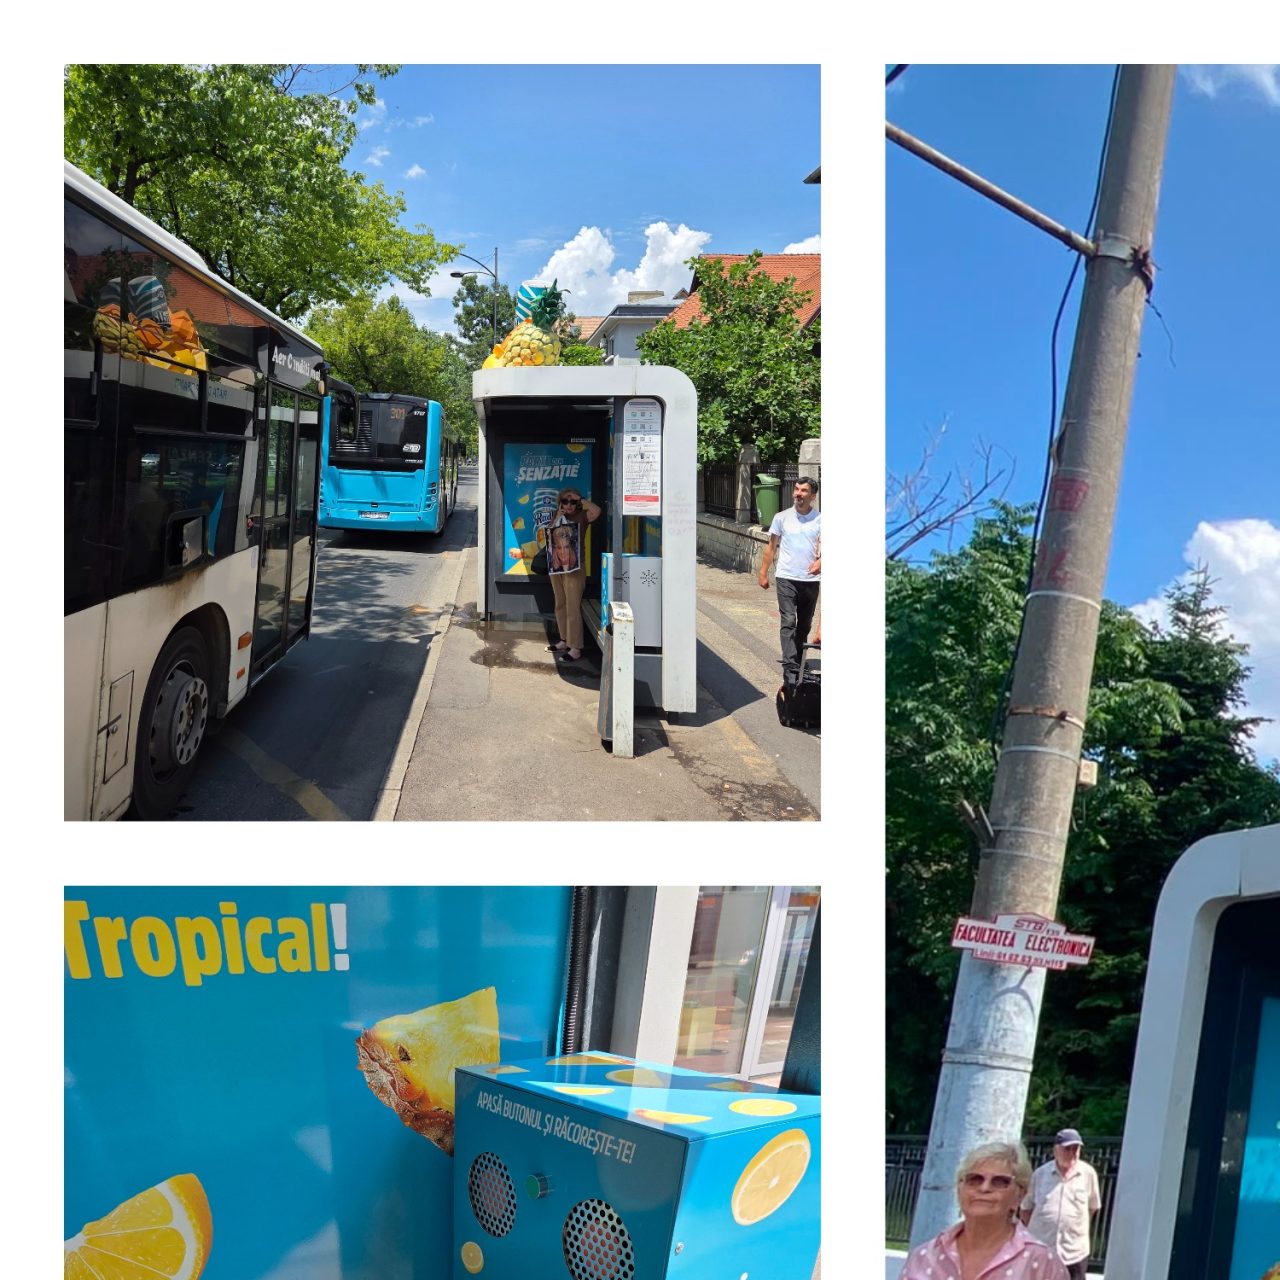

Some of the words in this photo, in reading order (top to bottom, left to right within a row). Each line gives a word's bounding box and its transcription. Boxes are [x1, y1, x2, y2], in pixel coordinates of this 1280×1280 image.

[64, 900, 350, 986] Tropical!
[955, 924, 1016, 948] FACULTATEA
[1025, 934, 1092, 958] ELECTRONICA
[477, 1091, 503, 1114] APASĂ
[503, 1100, 542, 1131] BUTONUL
[553, 1115, 637, 1164] RĂCOREȘTE-TE!
